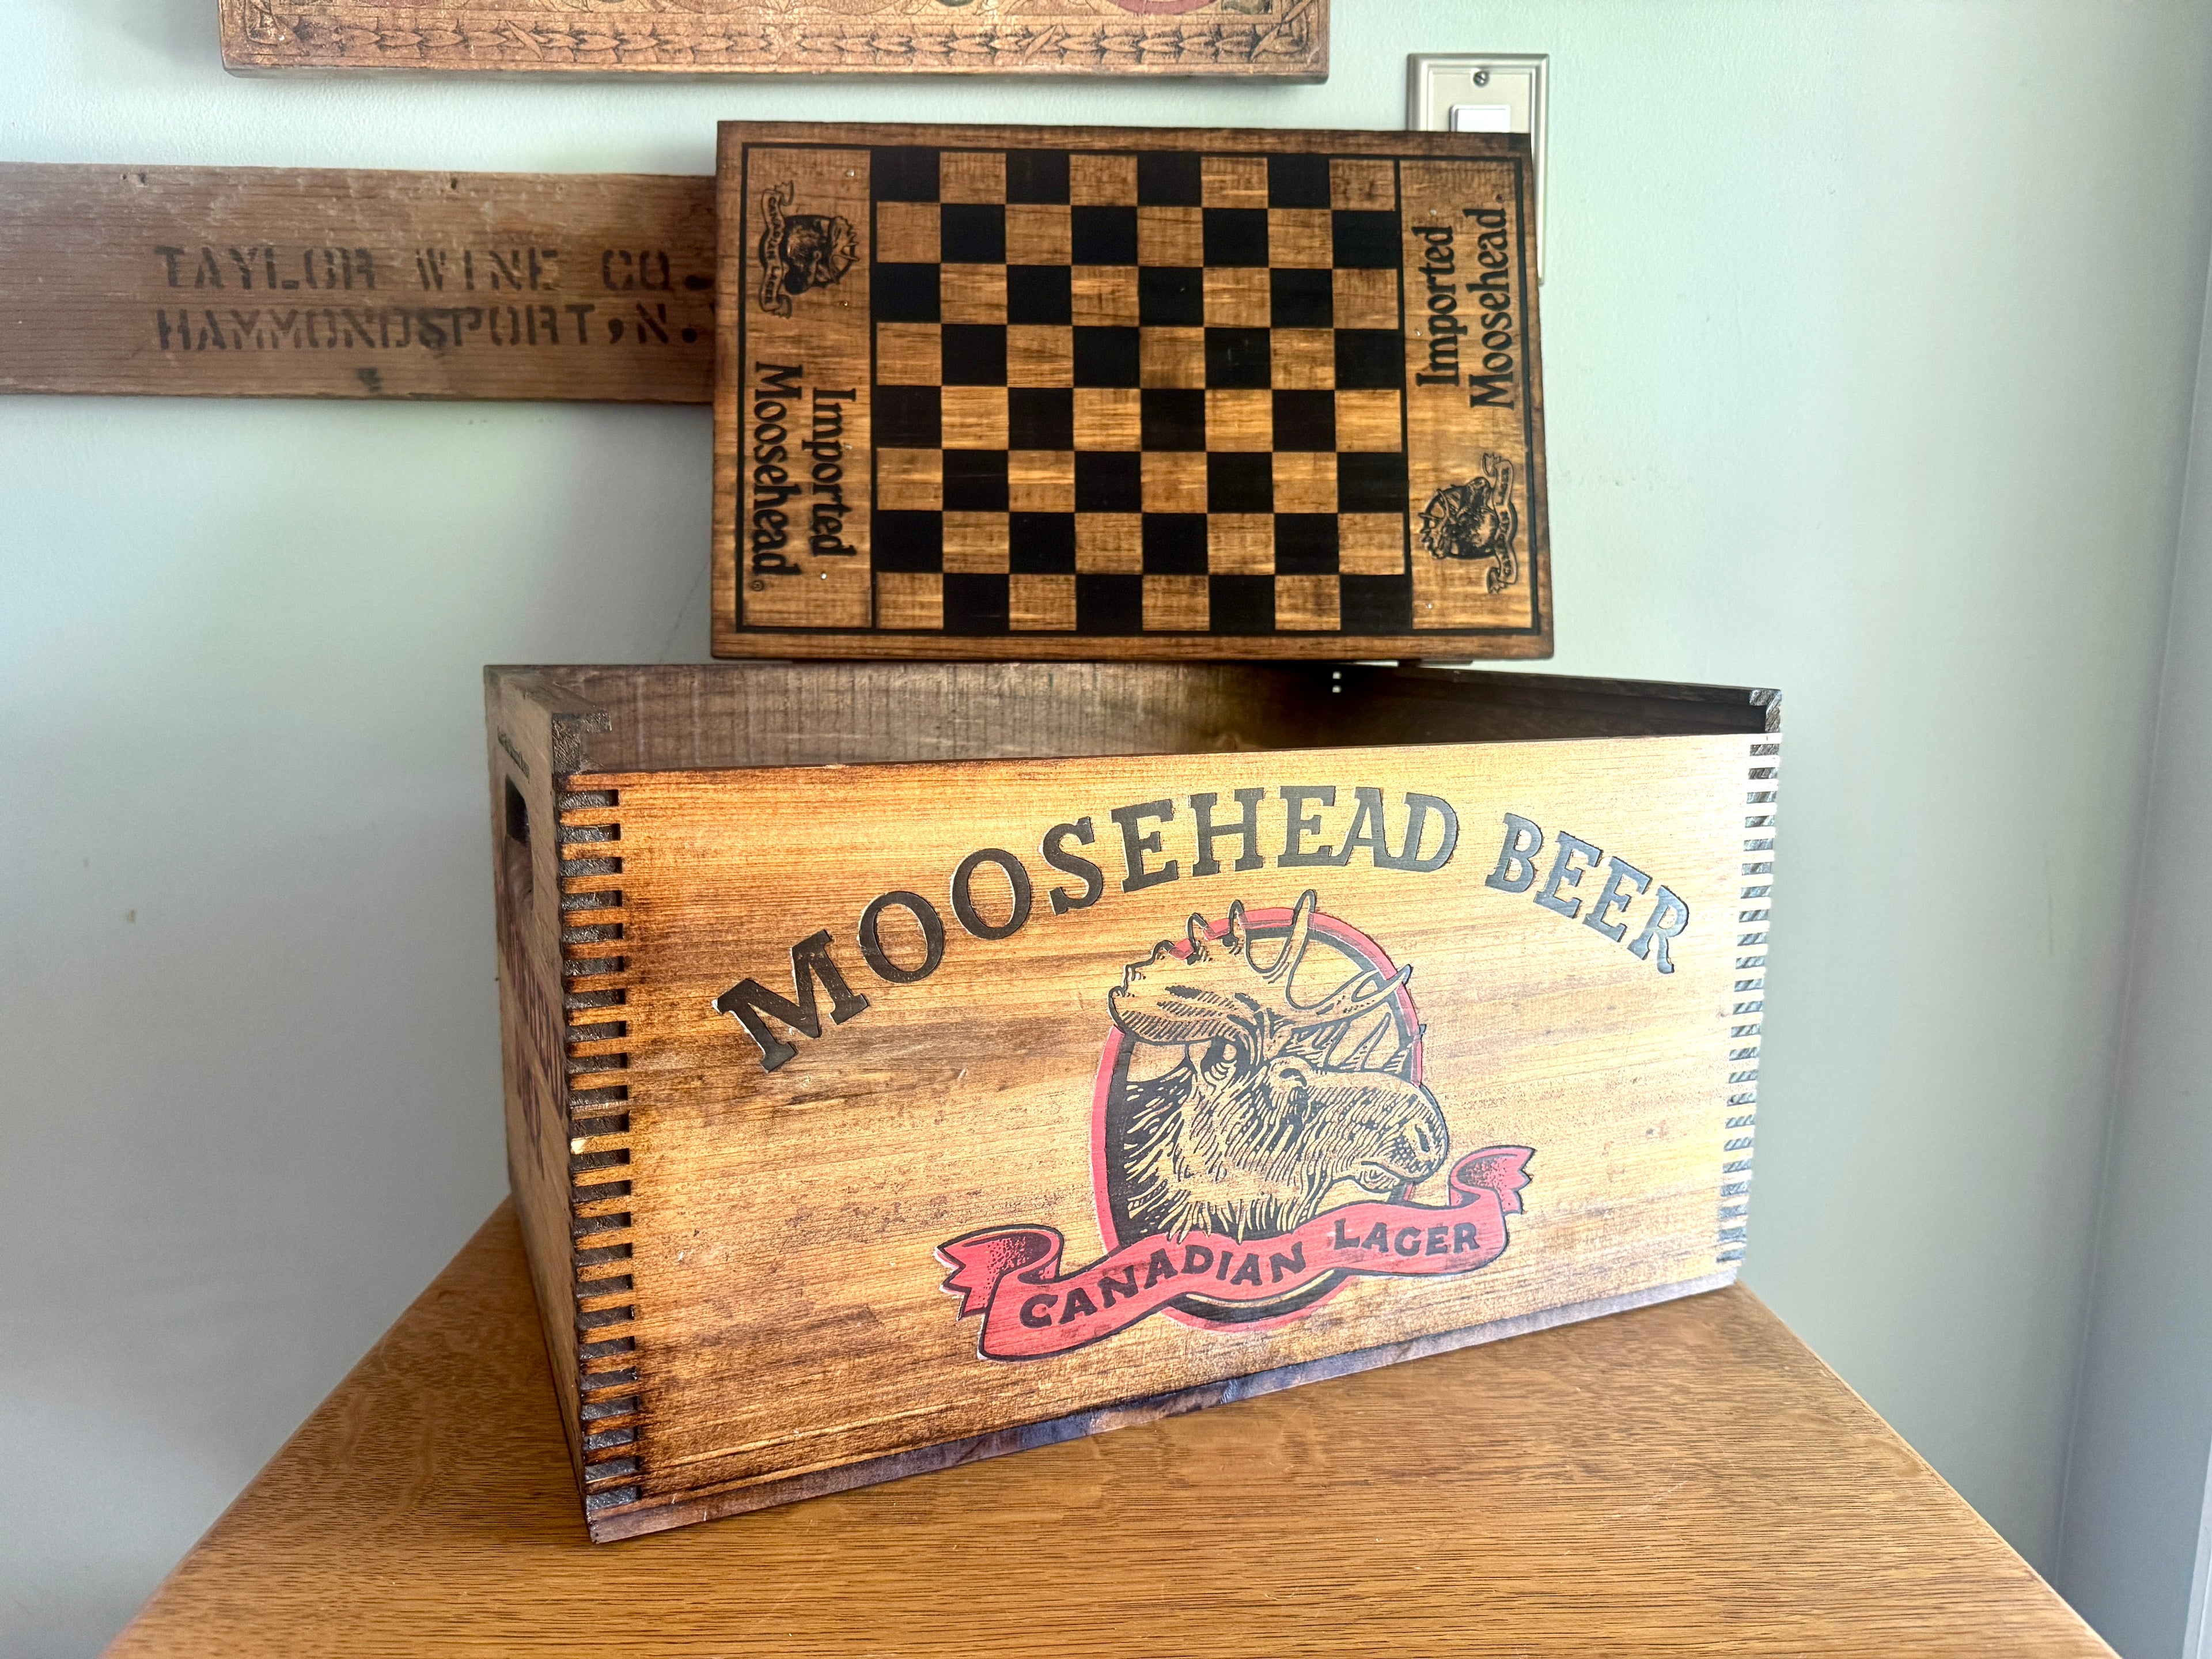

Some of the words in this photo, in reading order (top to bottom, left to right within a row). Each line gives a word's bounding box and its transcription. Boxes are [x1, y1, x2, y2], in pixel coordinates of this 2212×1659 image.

[153, 245, 376, 290] TAYLOR
[416, 247, 559, 291] WINE
[1411, 225, 1467, 387] Imported
[1463, 207, 1514, 410] Moosehead
[751, 361, 803, 576] Moosehead
[801, 387, 857, 558] Imported
[711, 785, 1459, 1074] MOOSEHEAD
[1484, 811, 1690, 975] BEER
[1020, 1241, 1305, 1329] CANADIAN
[1332, 1217, 1482, 1257] LAGER
